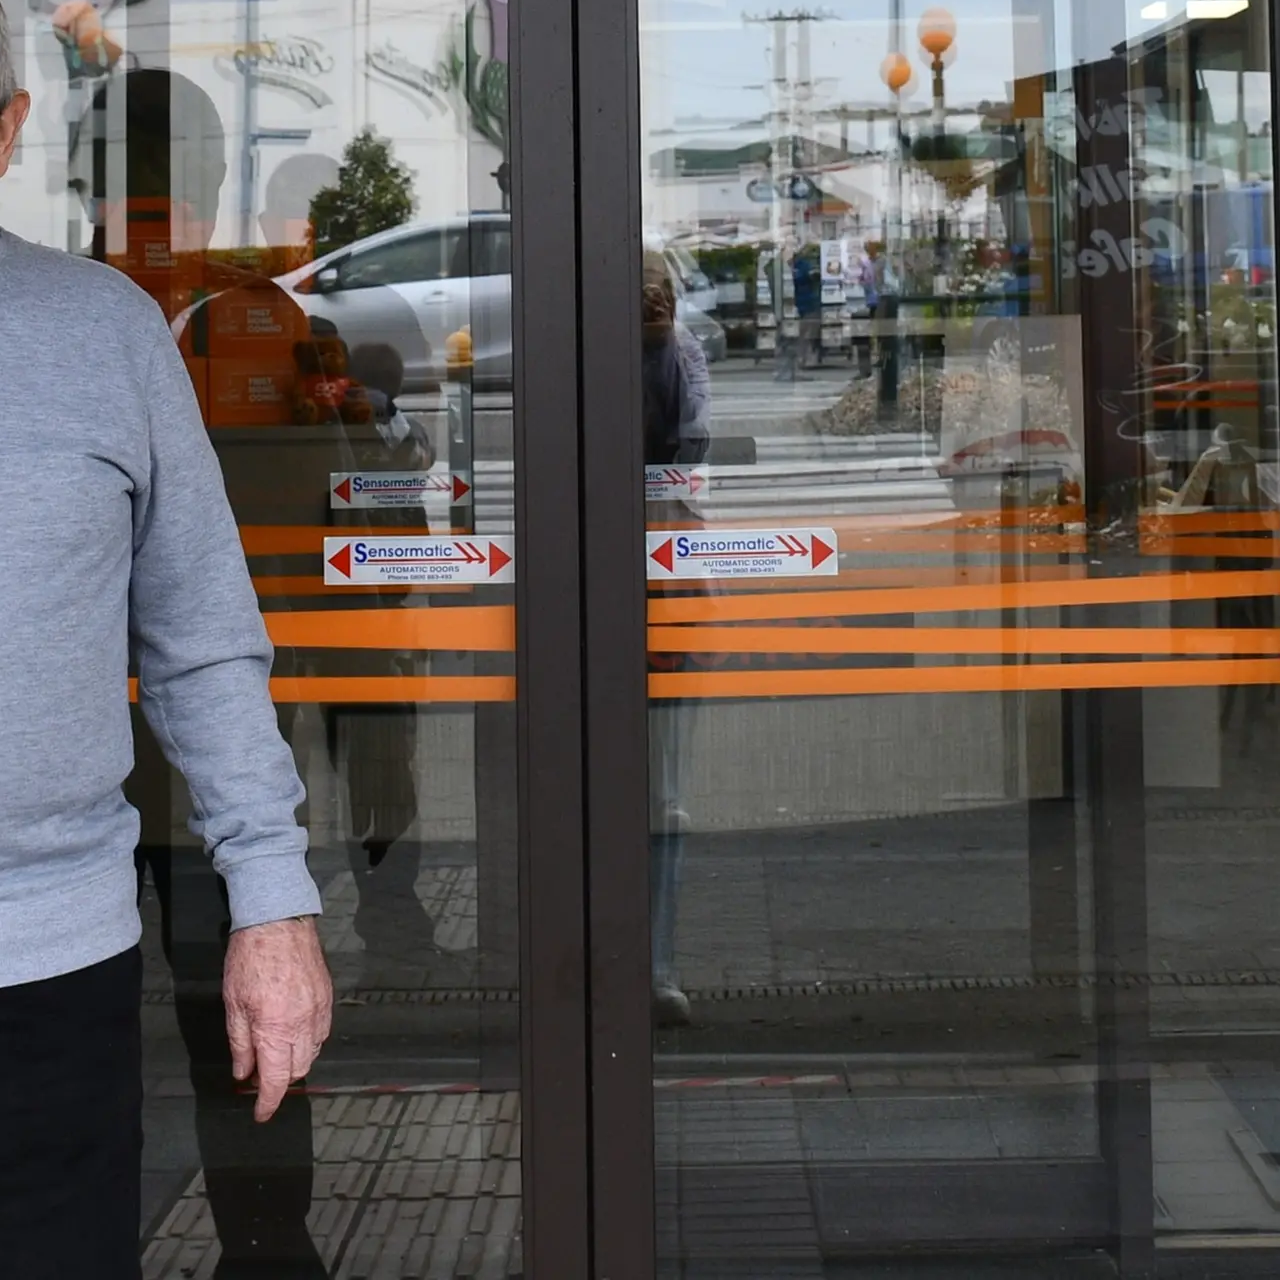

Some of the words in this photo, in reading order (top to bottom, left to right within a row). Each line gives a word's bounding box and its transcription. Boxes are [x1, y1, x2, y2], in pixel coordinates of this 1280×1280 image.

[354, 542, 453, 563] Sensormatic
[676, 536, 775, 557] Sensormatic
[380, 566, 427, 574] AUTOMATIC
[429, 565, 460, 573] DOORS
[702, 559, 750, 567] AUTOMATIC
[752, 558, 782, 566] DOORS
